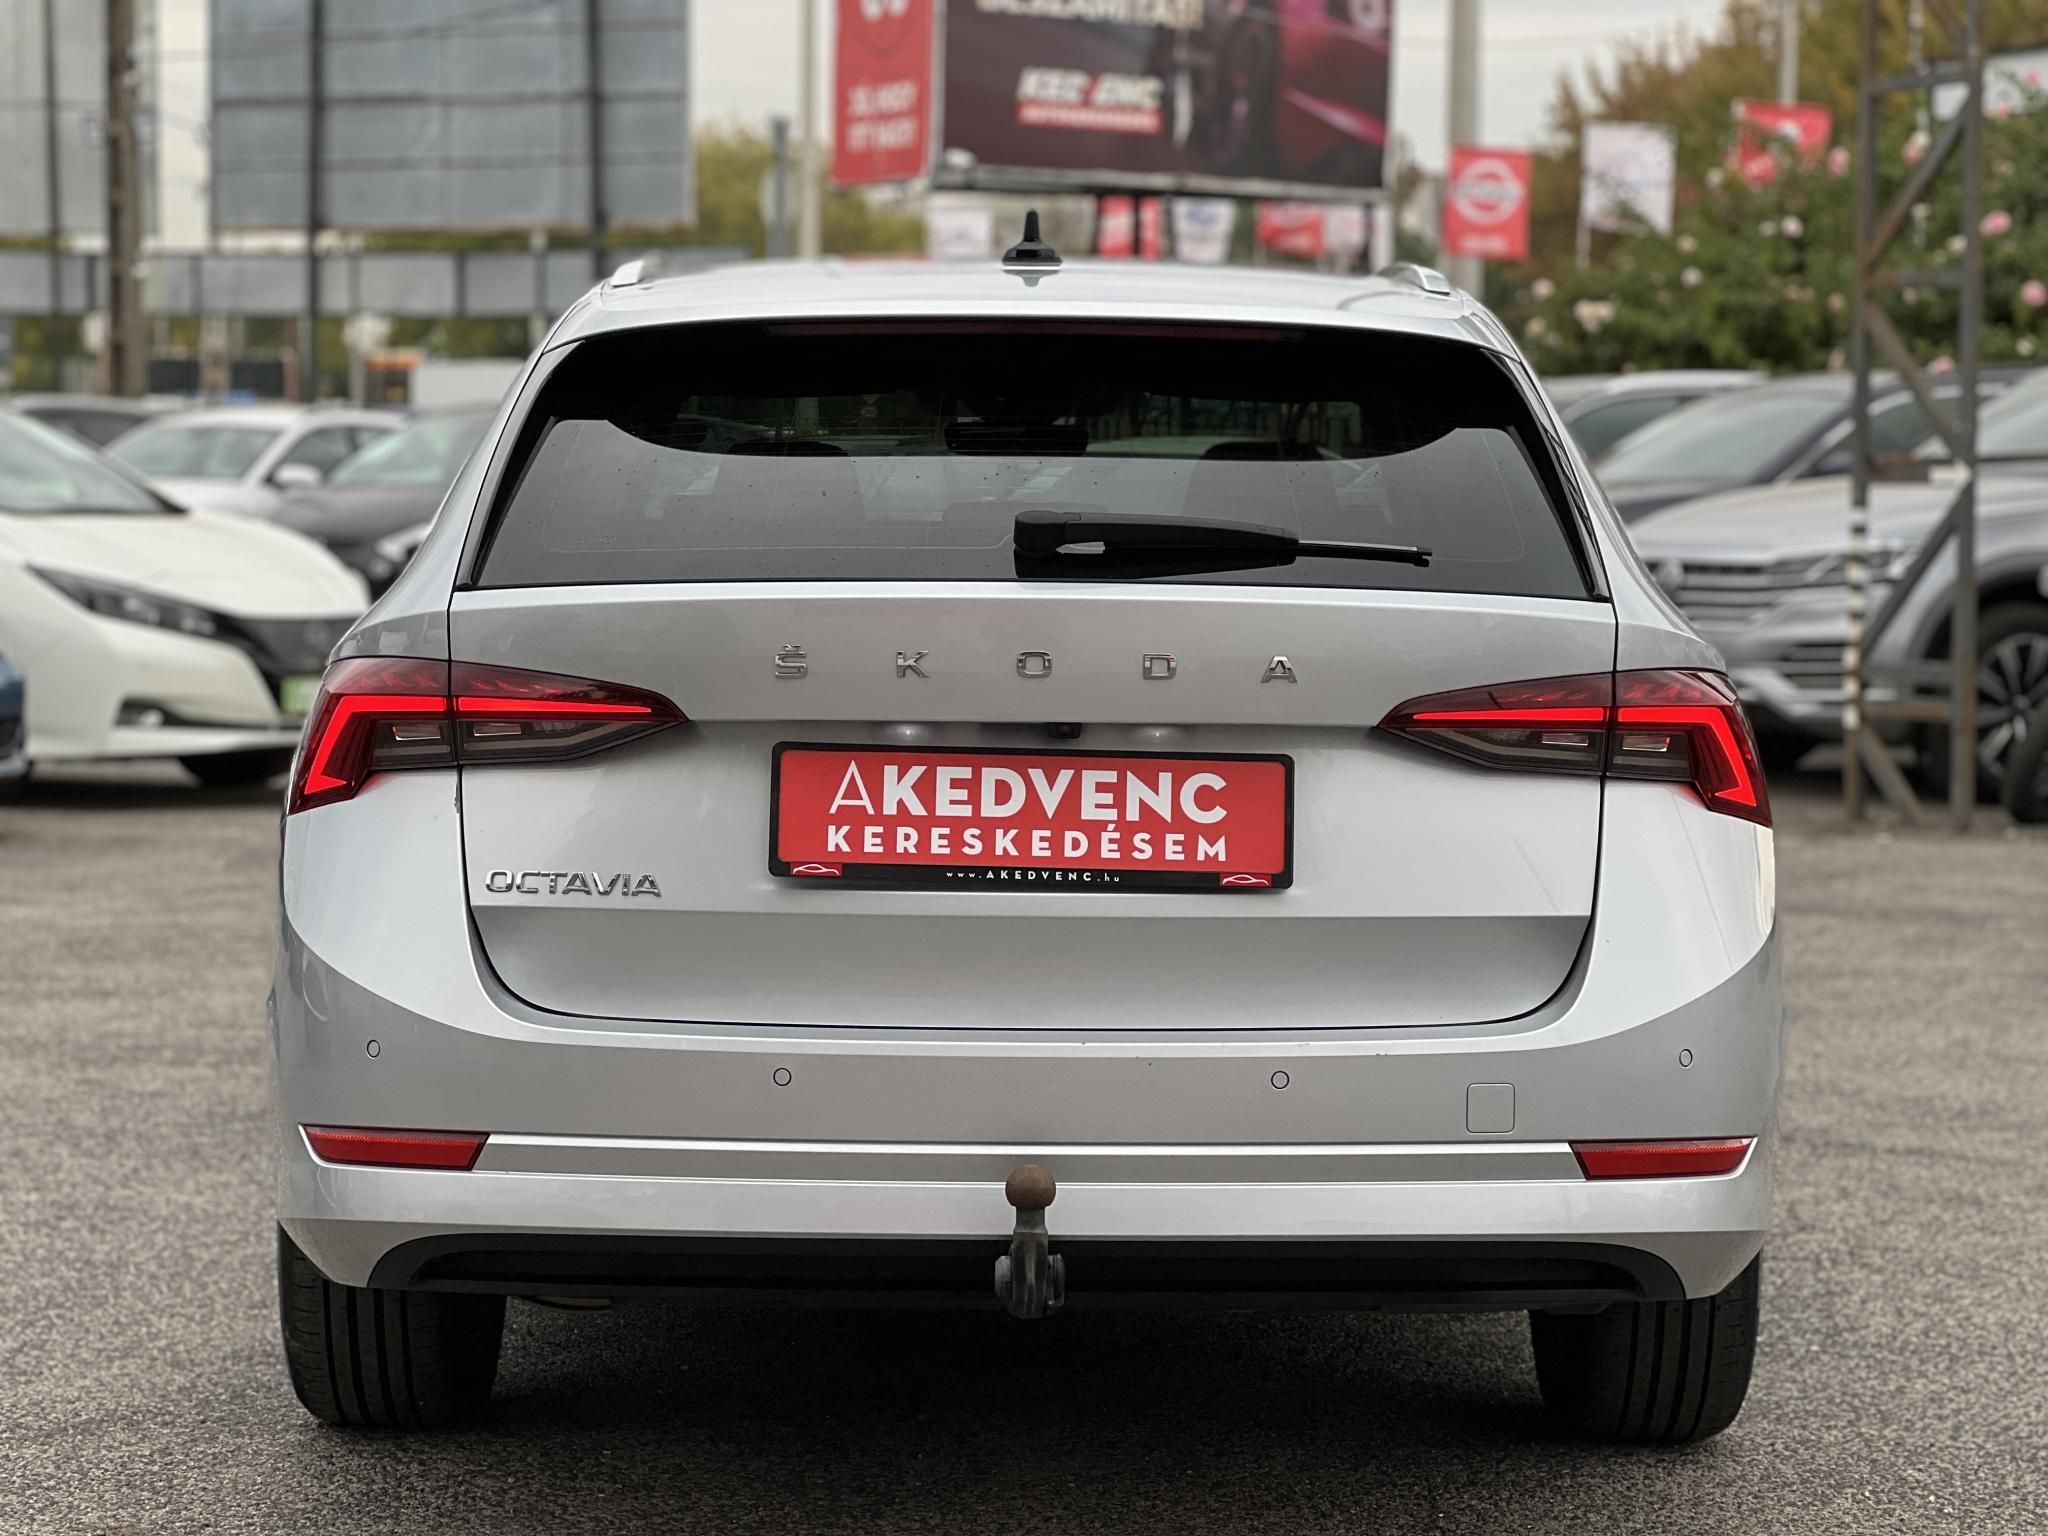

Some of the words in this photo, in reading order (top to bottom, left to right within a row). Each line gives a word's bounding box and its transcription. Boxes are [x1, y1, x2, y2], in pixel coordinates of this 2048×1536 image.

[774, 644, 1298, 684] ŠKODA
[828, 759, 1228, 825] AKEDVENC
[827, 823, 1227, 862] KERESKEDÉSEM
[485, 869, 662, 898] OCTAVIA
[946, 869, 1121, 883] www.AKEDVENC.hu
